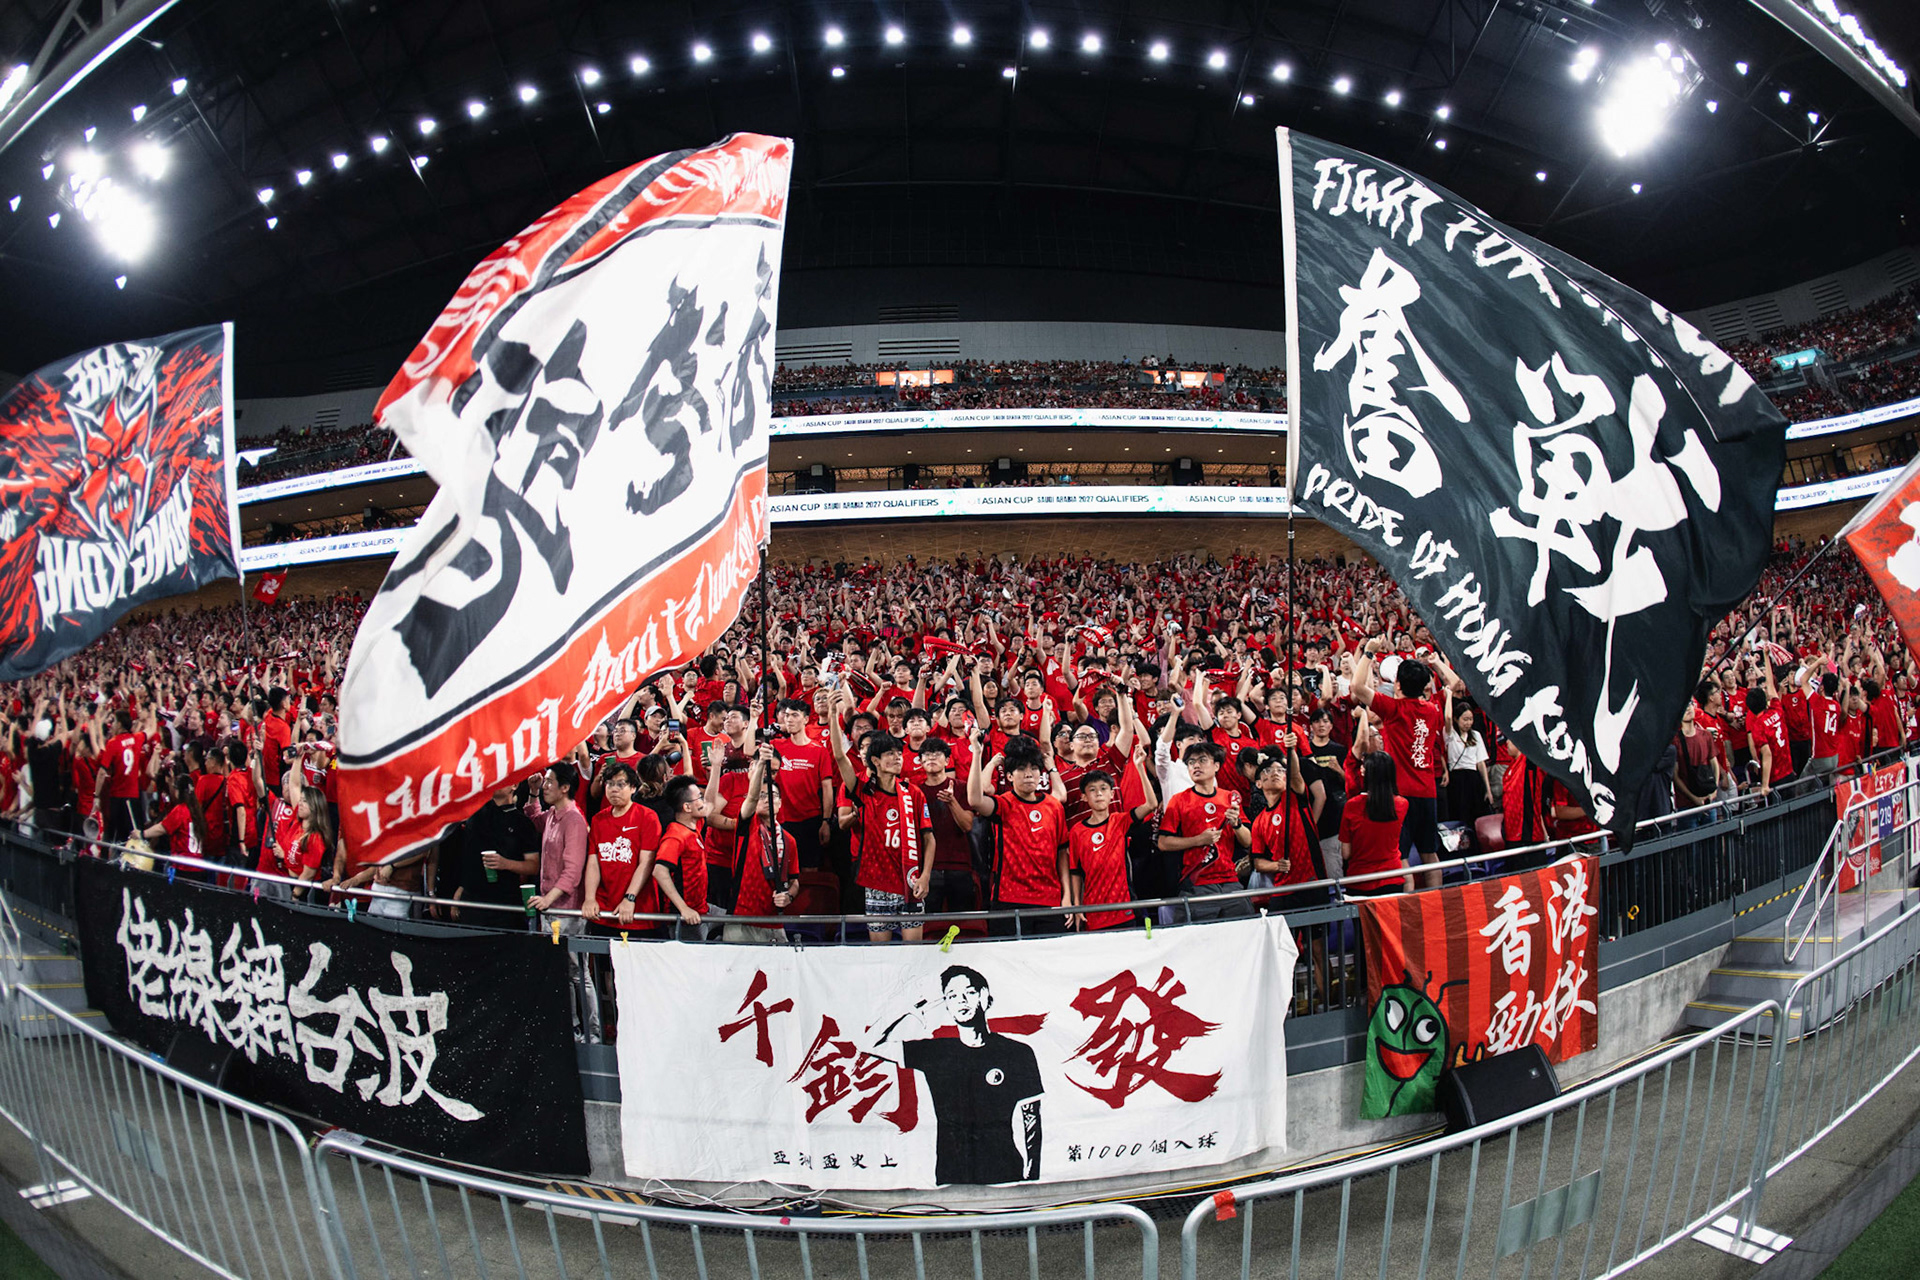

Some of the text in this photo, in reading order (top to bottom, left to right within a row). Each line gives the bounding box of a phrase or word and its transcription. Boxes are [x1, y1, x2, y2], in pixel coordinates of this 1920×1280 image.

[1312, 158, 1562, 308] FIGHT FOR
[804, 420, 827, 428] ASIAN
[885, 416, 925, 424] QUALIFIERS
[769, 503, 799, 513] ASIAN
[800, 503, 821, 512] CUP
[865, 500, 882, 509] 2027
[883, 499, 940, 508] QUALIFIERS
[981, 496, 1012, 505] ASIAN
[1013, 496, 1034, 504] CUP
[1078, 495, 1094, 503] 2027
[1095, 495, 1150, 503] QUALIFIERS
[1188, 495, 1216, 503] ASIAN
[1217, 495, 1236, 503] CUP
[1313, 247, 1722, 775] 奮戰
[361, 538, 395, 548] QUALIFIERS
[1303, 462, 1617, 826] PRIDE OF HONG KONG
[1824, 711, 1838, 736] 14
[122, 749, 135, 776] 9
[1879, 805, 1892, 827] 219
[884, 828, 901, 849] 16
[1479, 861, 1598, 977] 香港
[717, 964, 1224, 1134] 千鈞一發
[1066, 1131, 1219, 1162] 第1000個入球
[773, 1150, 898, 1171] 亞洲盃史上
